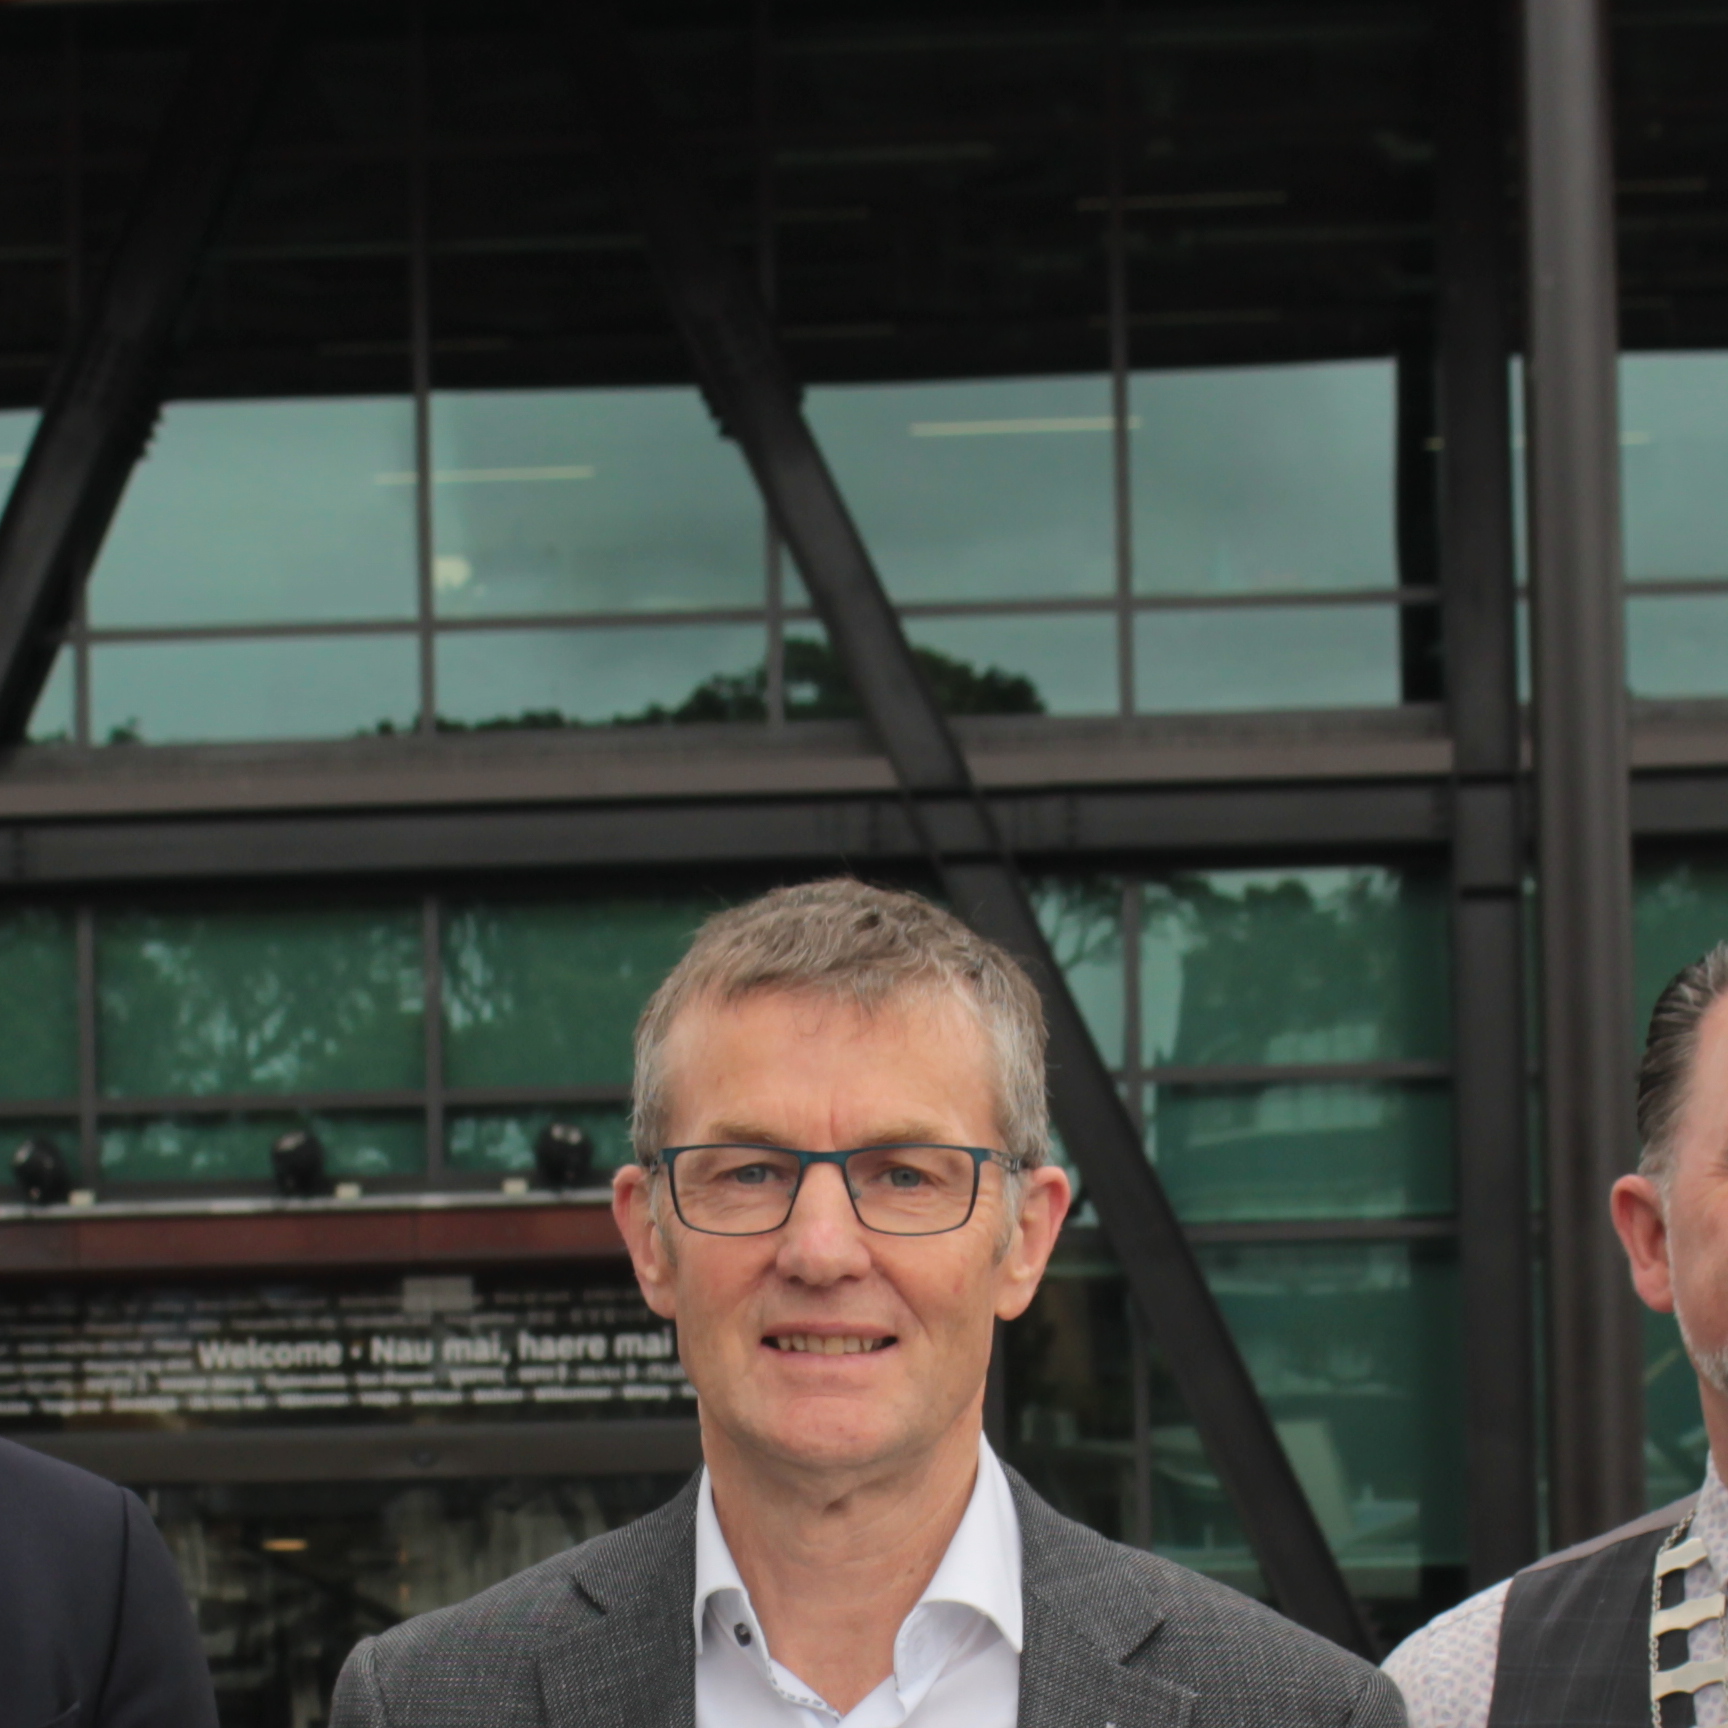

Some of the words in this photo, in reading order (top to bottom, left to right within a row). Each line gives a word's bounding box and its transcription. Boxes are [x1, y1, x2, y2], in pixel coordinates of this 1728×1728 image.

[197, 1337, 344, 1371] Welcome
[369, 1336, 433, 1366] Nau
[442, 1331, 512, 1365] mai,
[518, 1327, 608, 1361] haere
[613, 1325, 673, 1359] mai
